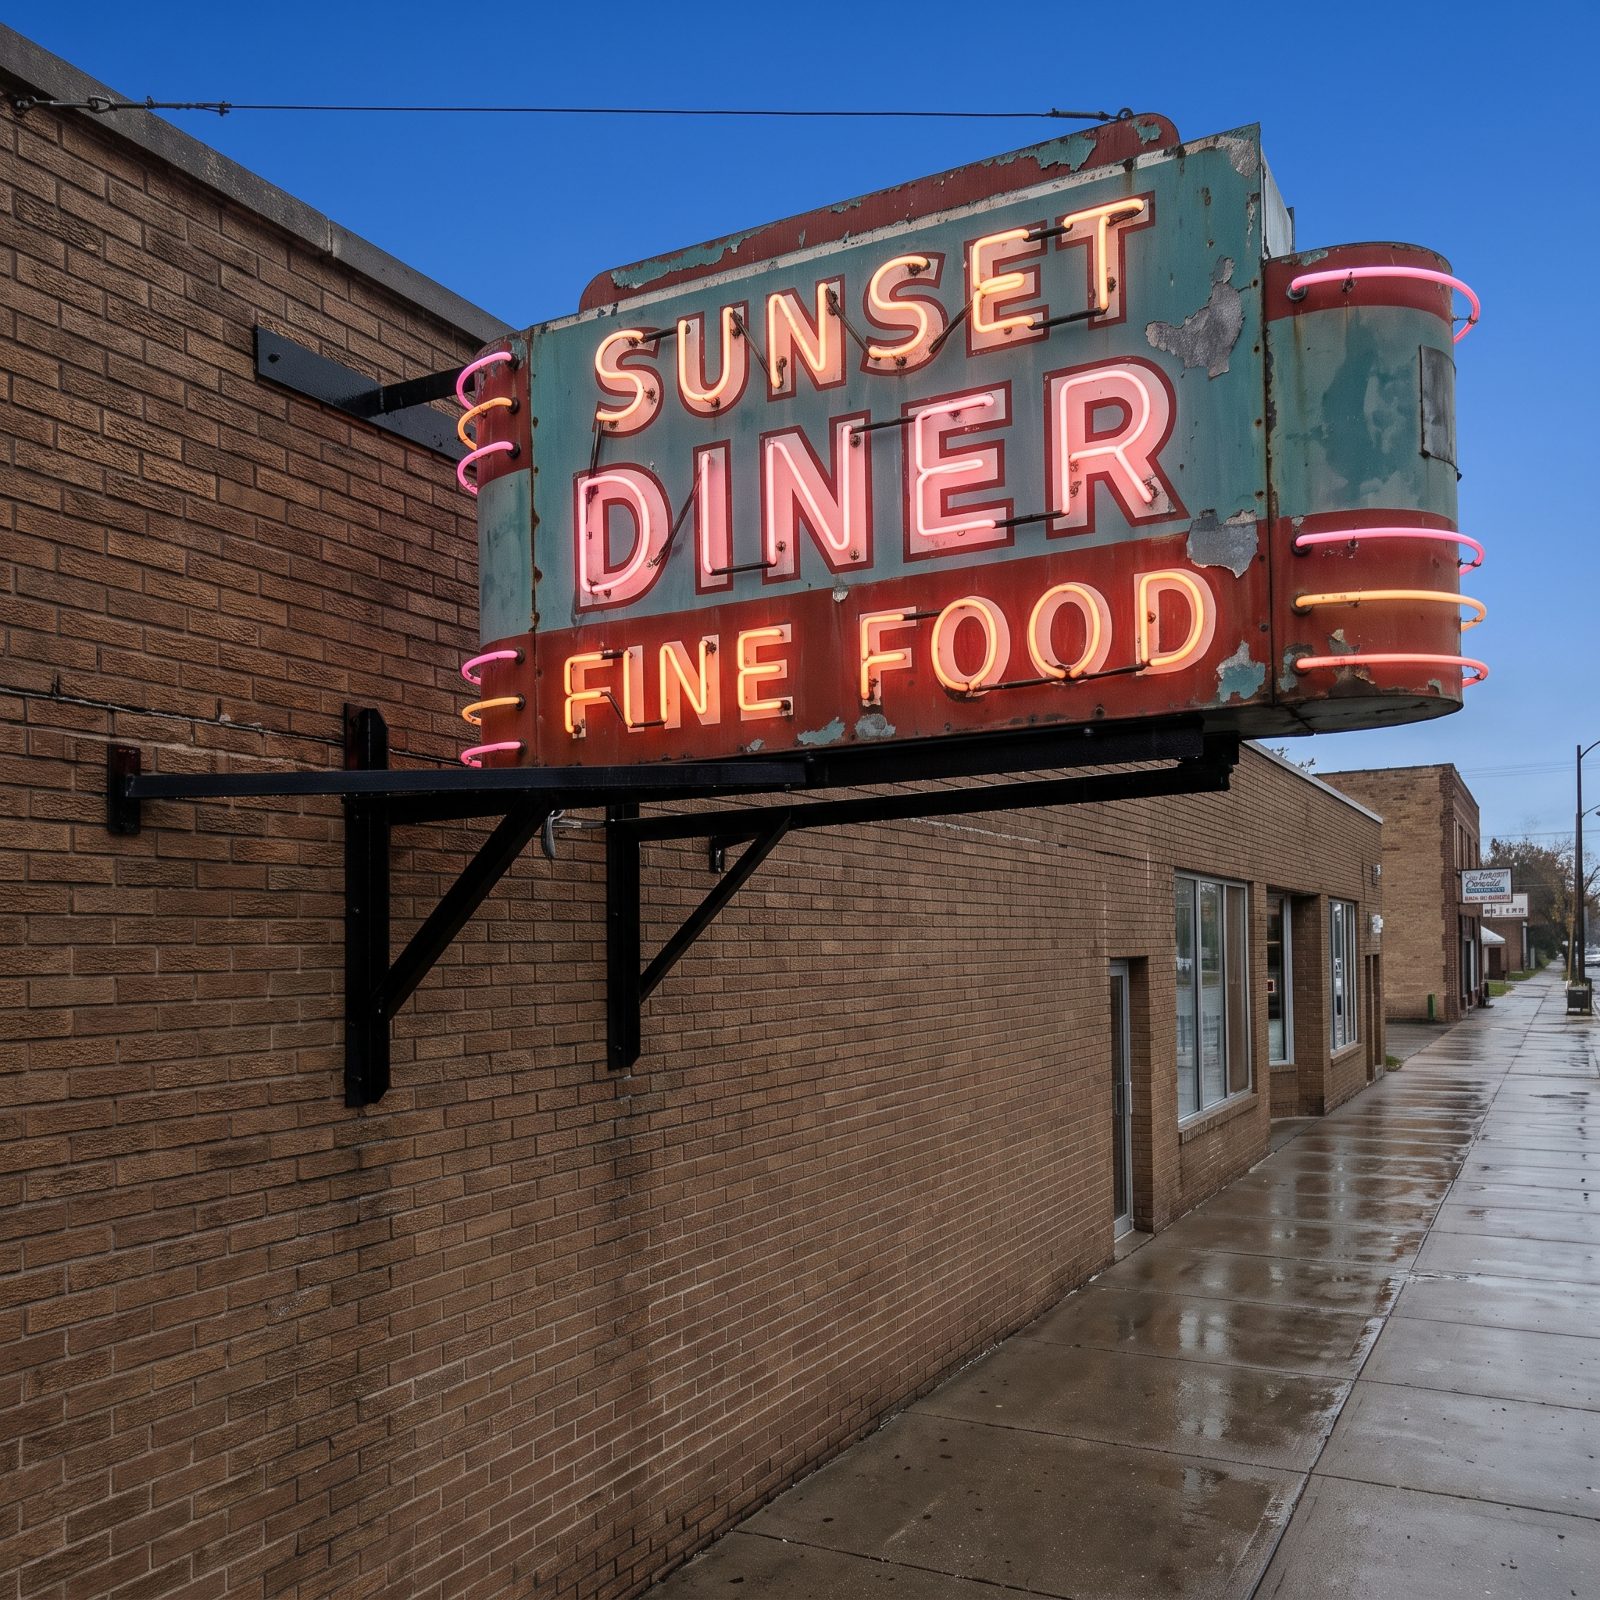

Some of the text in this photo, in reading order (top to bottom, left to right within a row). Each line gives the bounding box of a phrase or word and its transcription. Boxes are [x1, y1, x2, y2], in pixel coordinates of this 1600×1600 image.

[595, 192, 1154, 436] SUNSET
[575, 357, 1188, 612] DINER
[564, 567, 1217, 738] FINE FOOD
